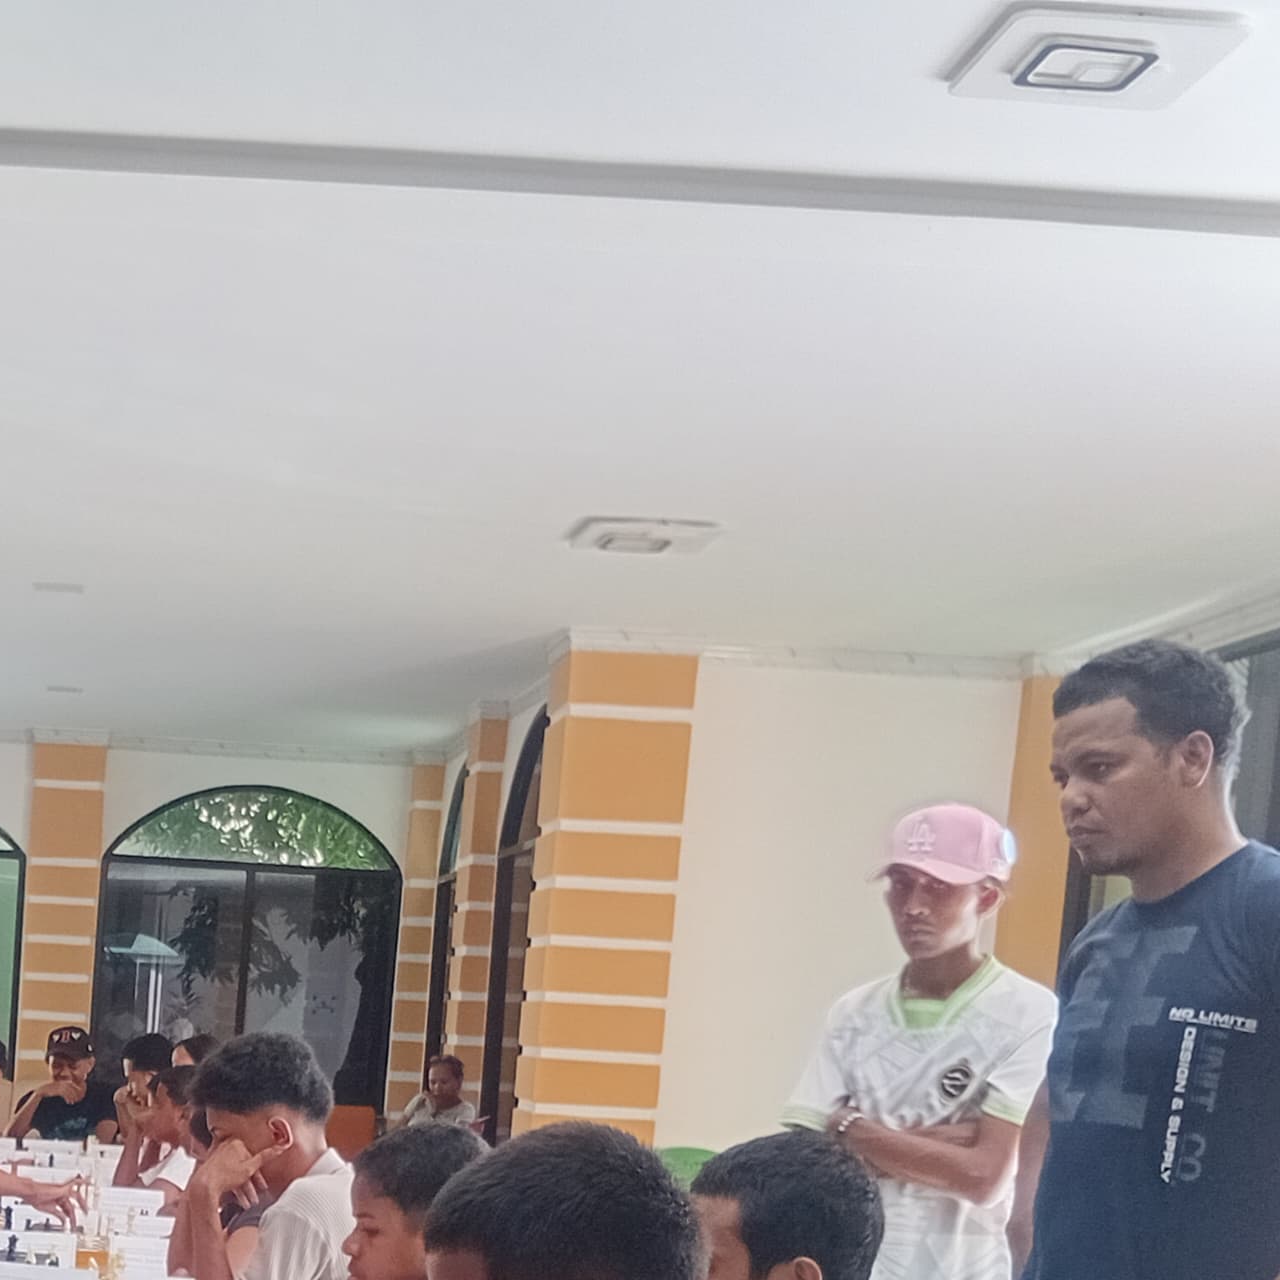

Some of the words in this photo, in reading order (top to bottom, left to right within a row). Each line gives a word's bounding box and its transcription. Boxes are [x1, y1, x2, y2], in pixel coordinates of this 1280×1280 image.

[1169, 1006, 1195, 1022] NO
[1173, 1026, 1197, 1093] DESIGN
[1160, 1114, 1182, 1183] SUPPLY
